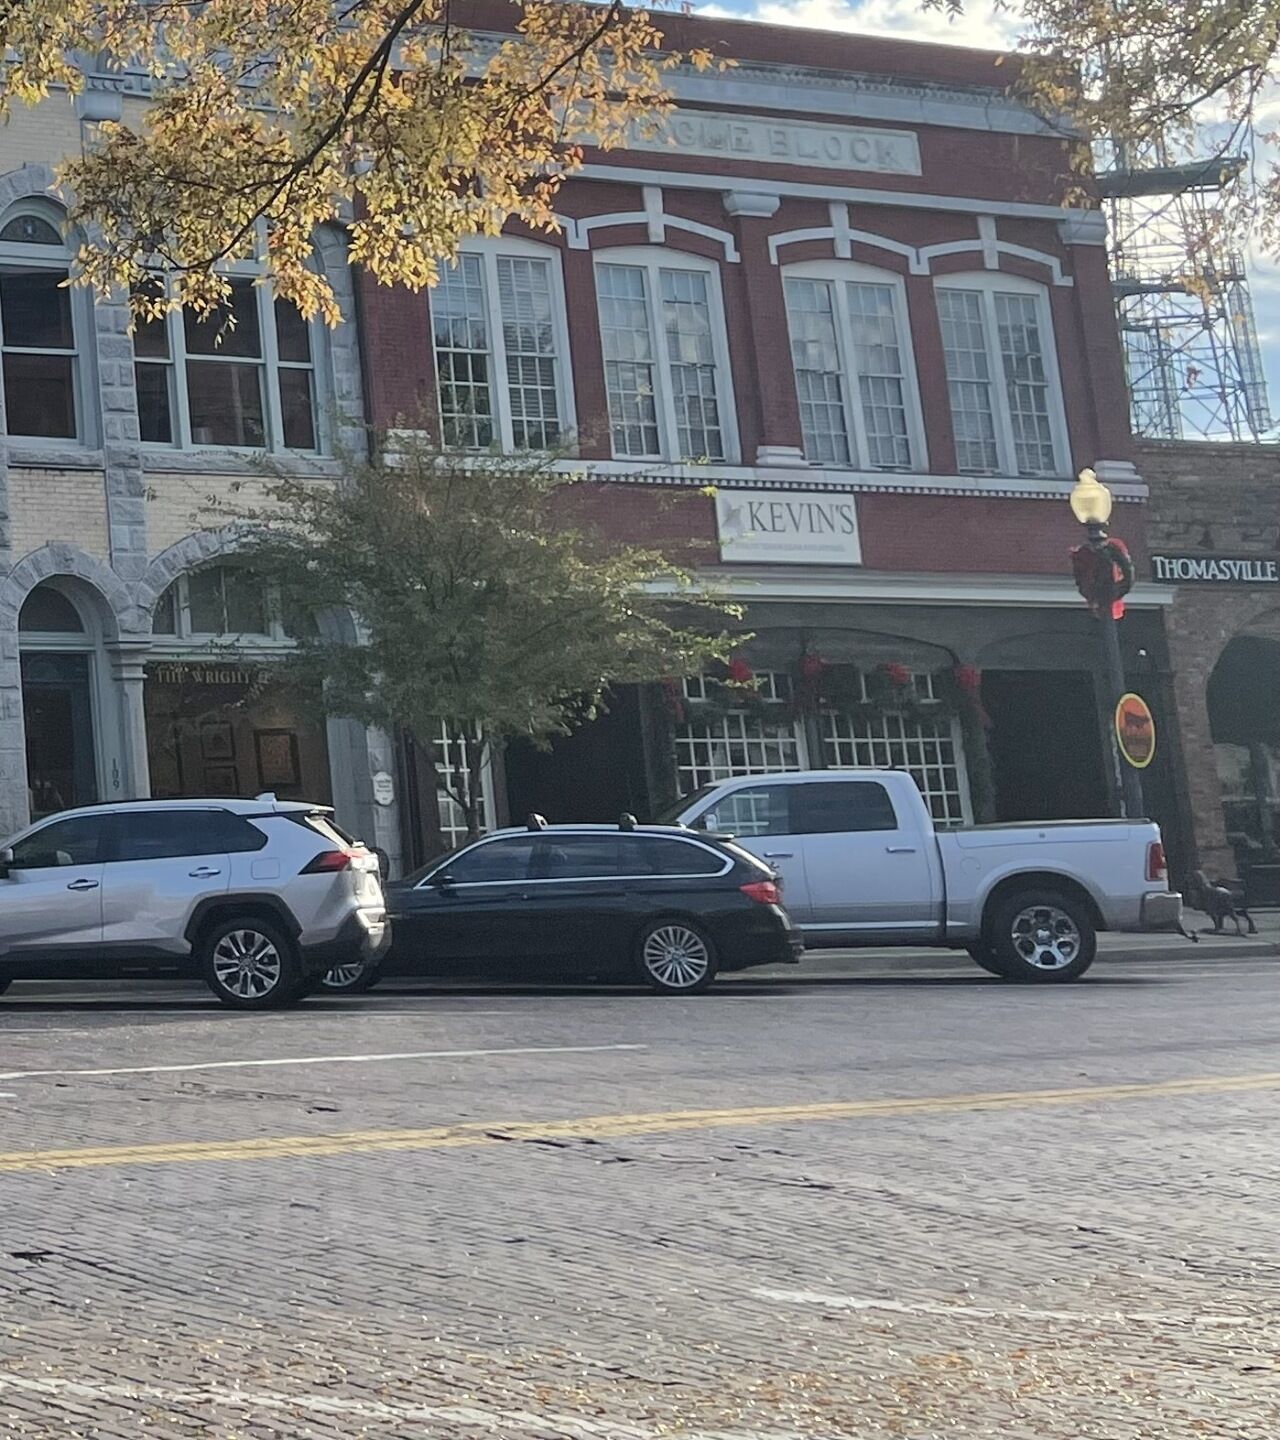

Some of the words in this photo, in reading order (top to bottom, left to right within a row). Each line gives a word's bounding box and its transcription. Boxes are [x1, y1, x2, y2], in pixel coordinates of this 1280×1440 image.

[768, 127, 904, 169] BLOCK
[747, 501, 855, 536] KEVIN'S
[1152, 555, 1279, 581] THOMASVILLE
